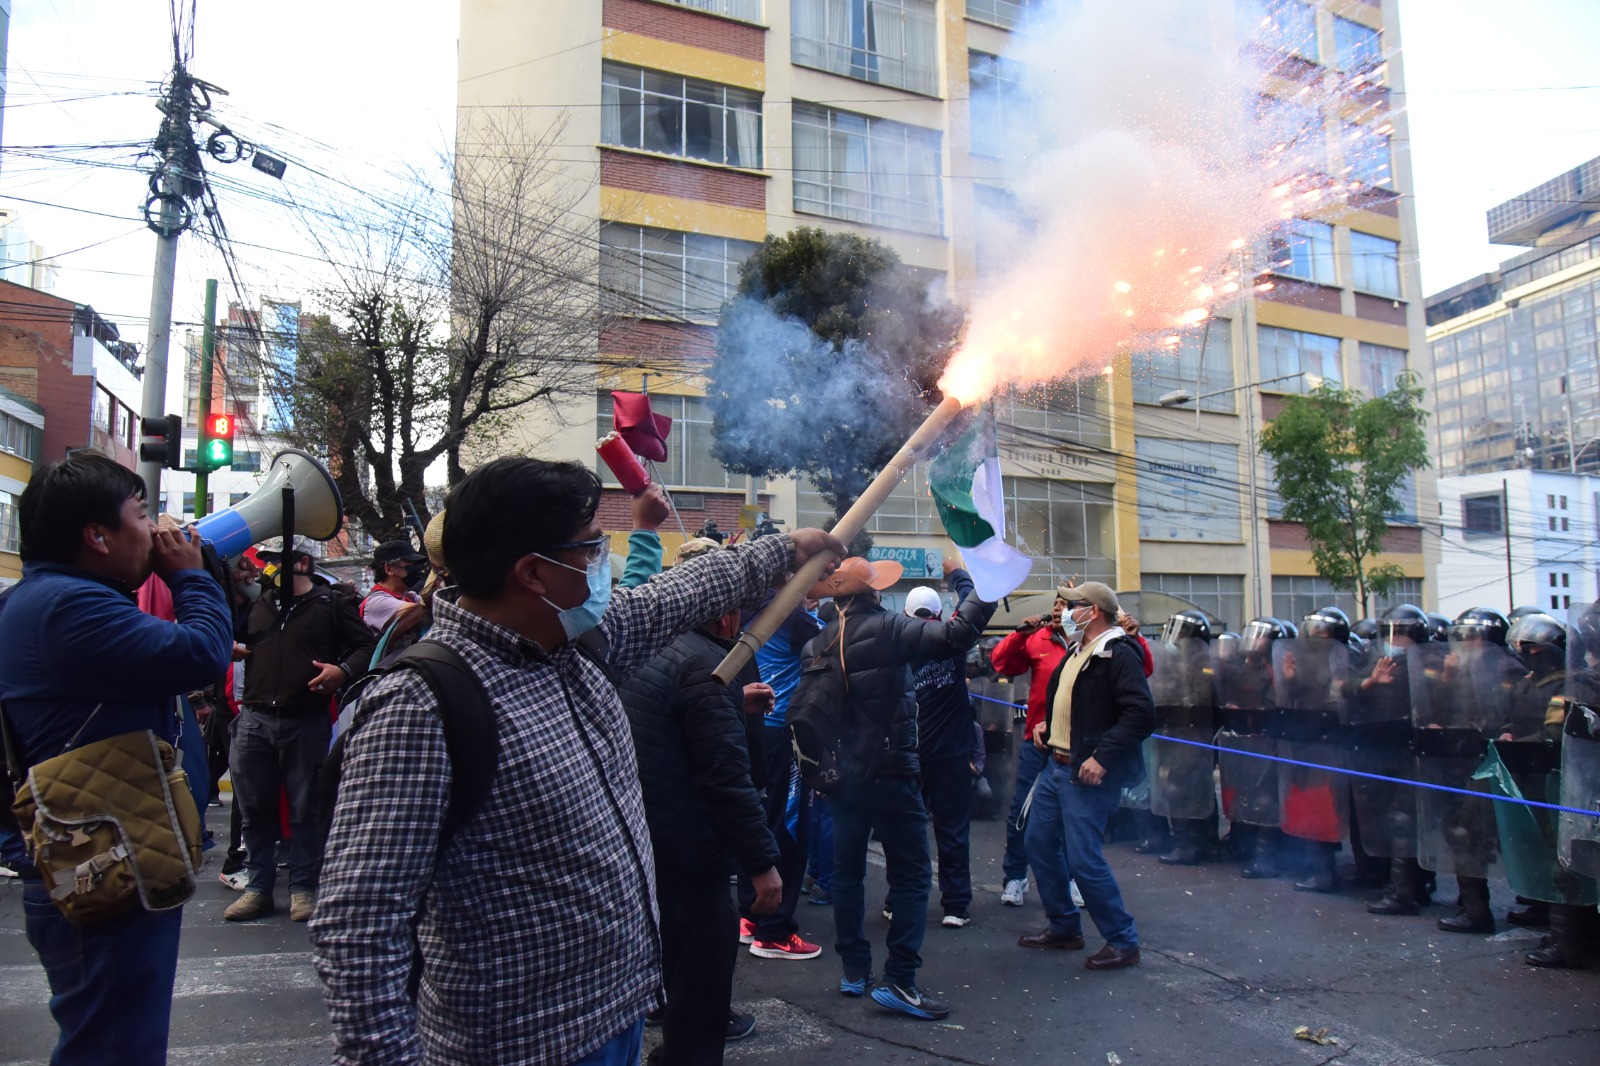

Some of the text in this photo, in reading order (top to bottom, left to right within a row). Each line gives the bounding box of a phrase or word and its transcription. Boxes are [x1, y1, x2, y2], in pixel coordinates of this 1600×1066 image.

[868, 548, 917, 562] OLOGIA
[912, 657, 956, 682] OTOSI
[820, 768, 840, 783] 23
